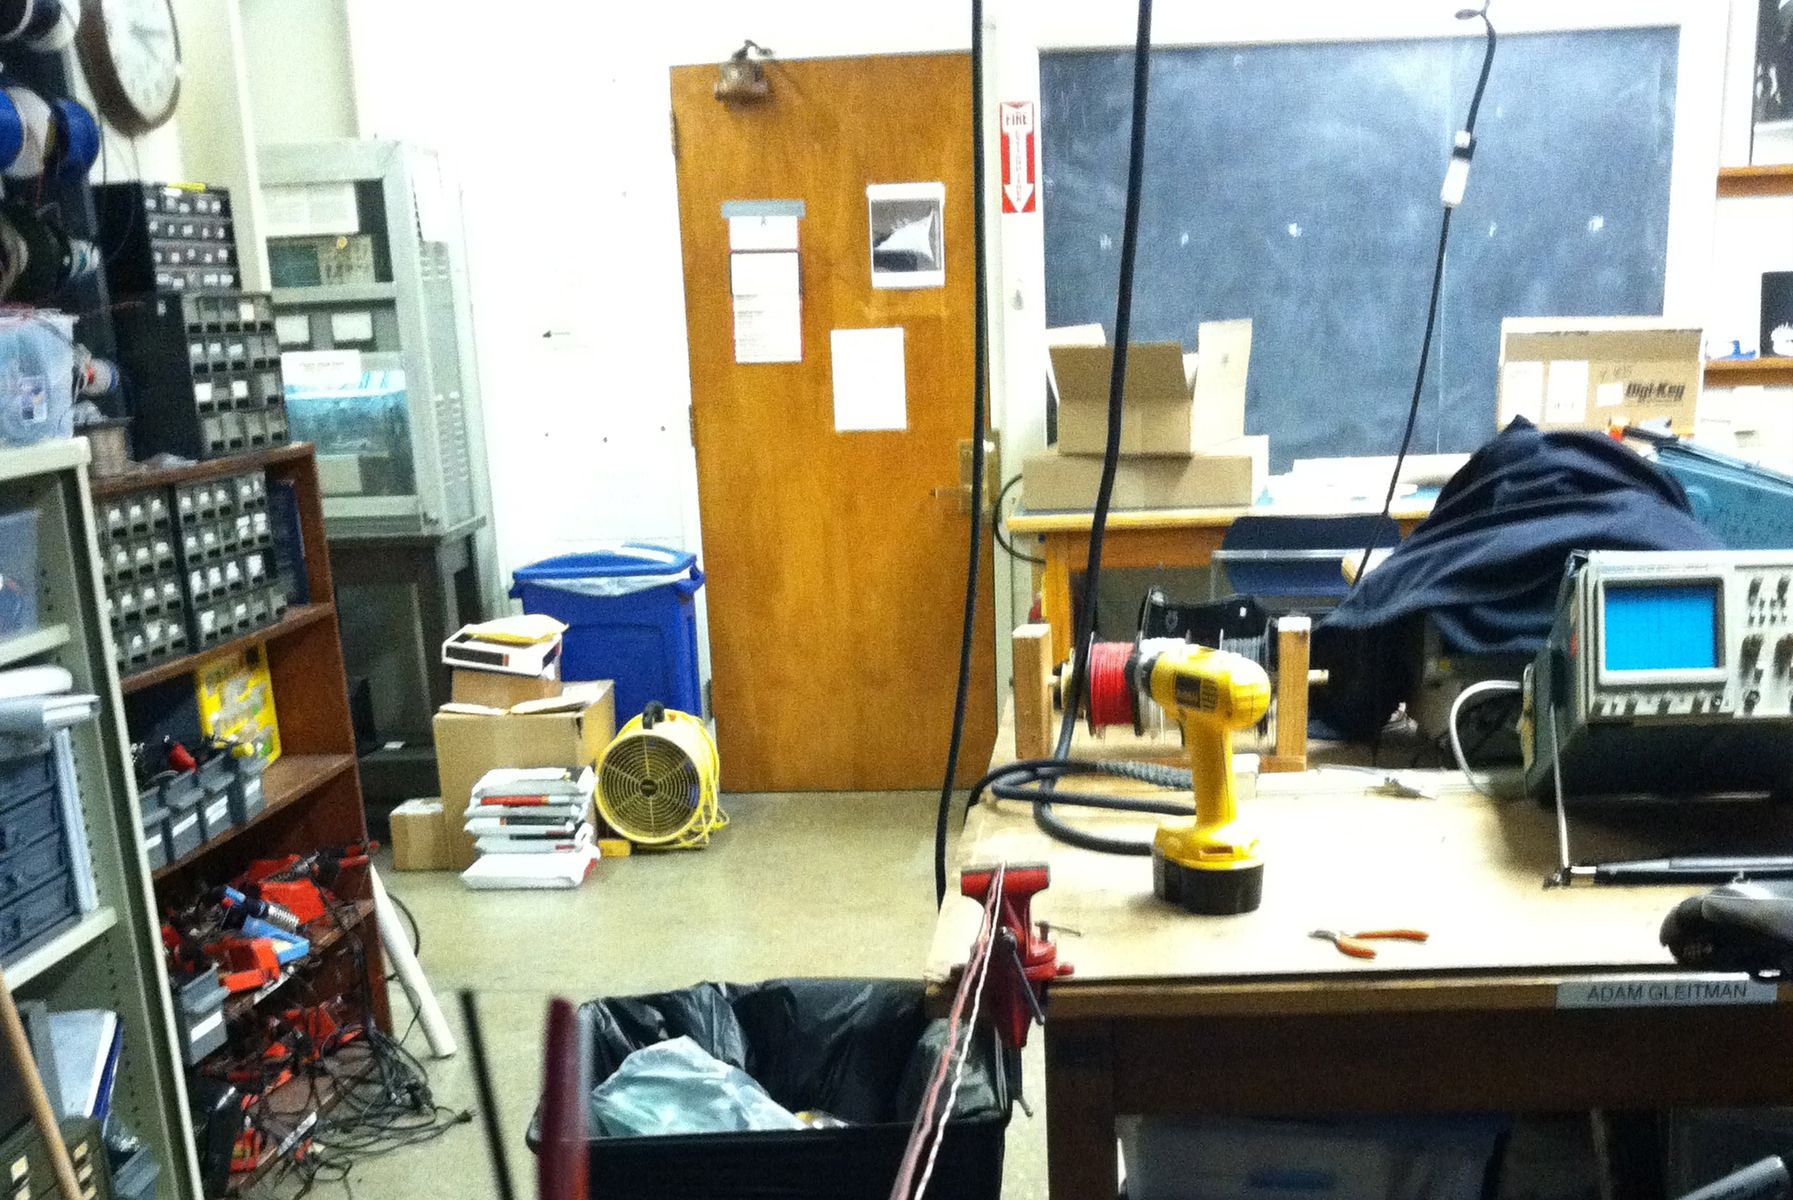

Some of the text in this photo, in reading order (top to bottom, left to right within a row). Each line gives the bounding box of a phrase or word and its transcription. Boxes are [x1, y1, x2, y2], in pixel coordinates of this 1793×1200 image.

[1005, 112, 1028, 126] FIRE
[1587, 983, 1747, 1001] ADAM GLEITMAN
